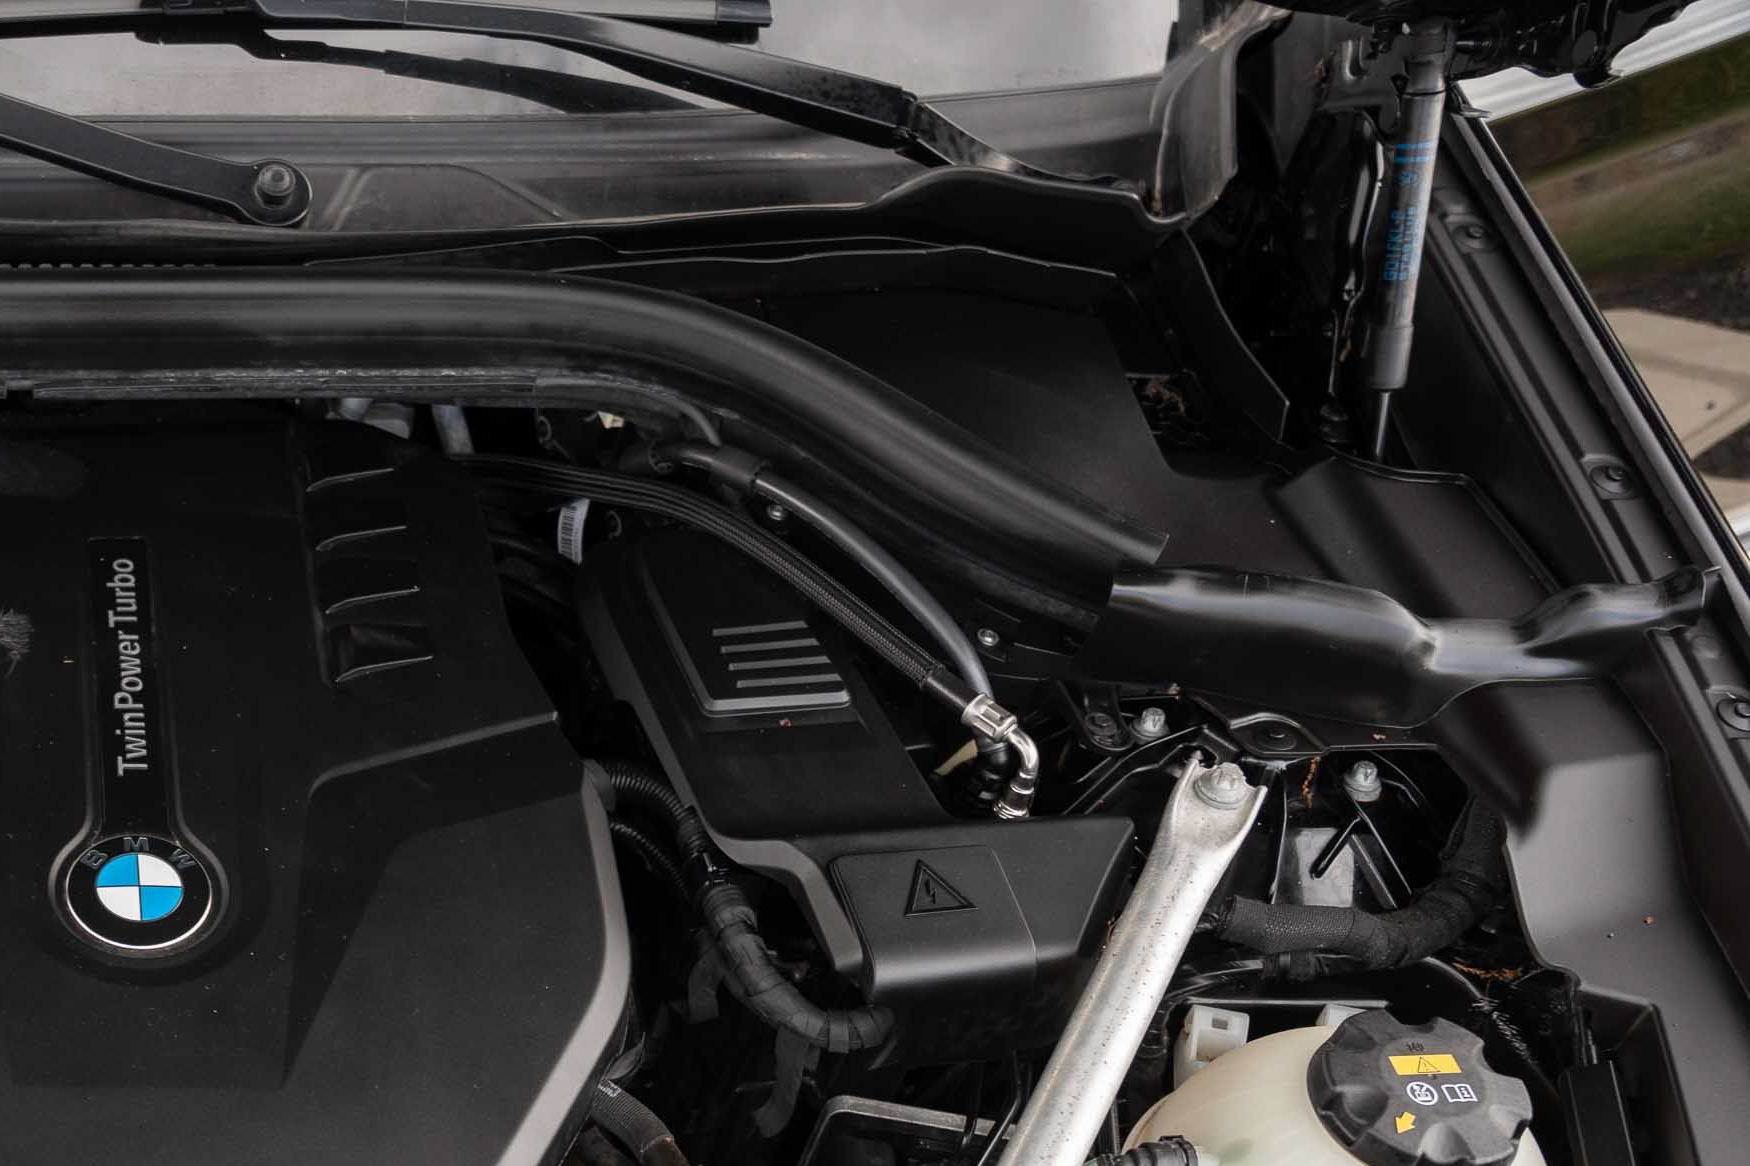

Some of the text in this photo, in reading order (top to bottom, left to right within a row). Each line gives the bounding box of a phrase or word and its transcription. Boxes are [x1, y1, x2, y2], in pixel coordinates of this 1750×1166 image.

[105, 557, 149, 777] TwinPower Turbo
[80, 836, 197, 870] BMW
